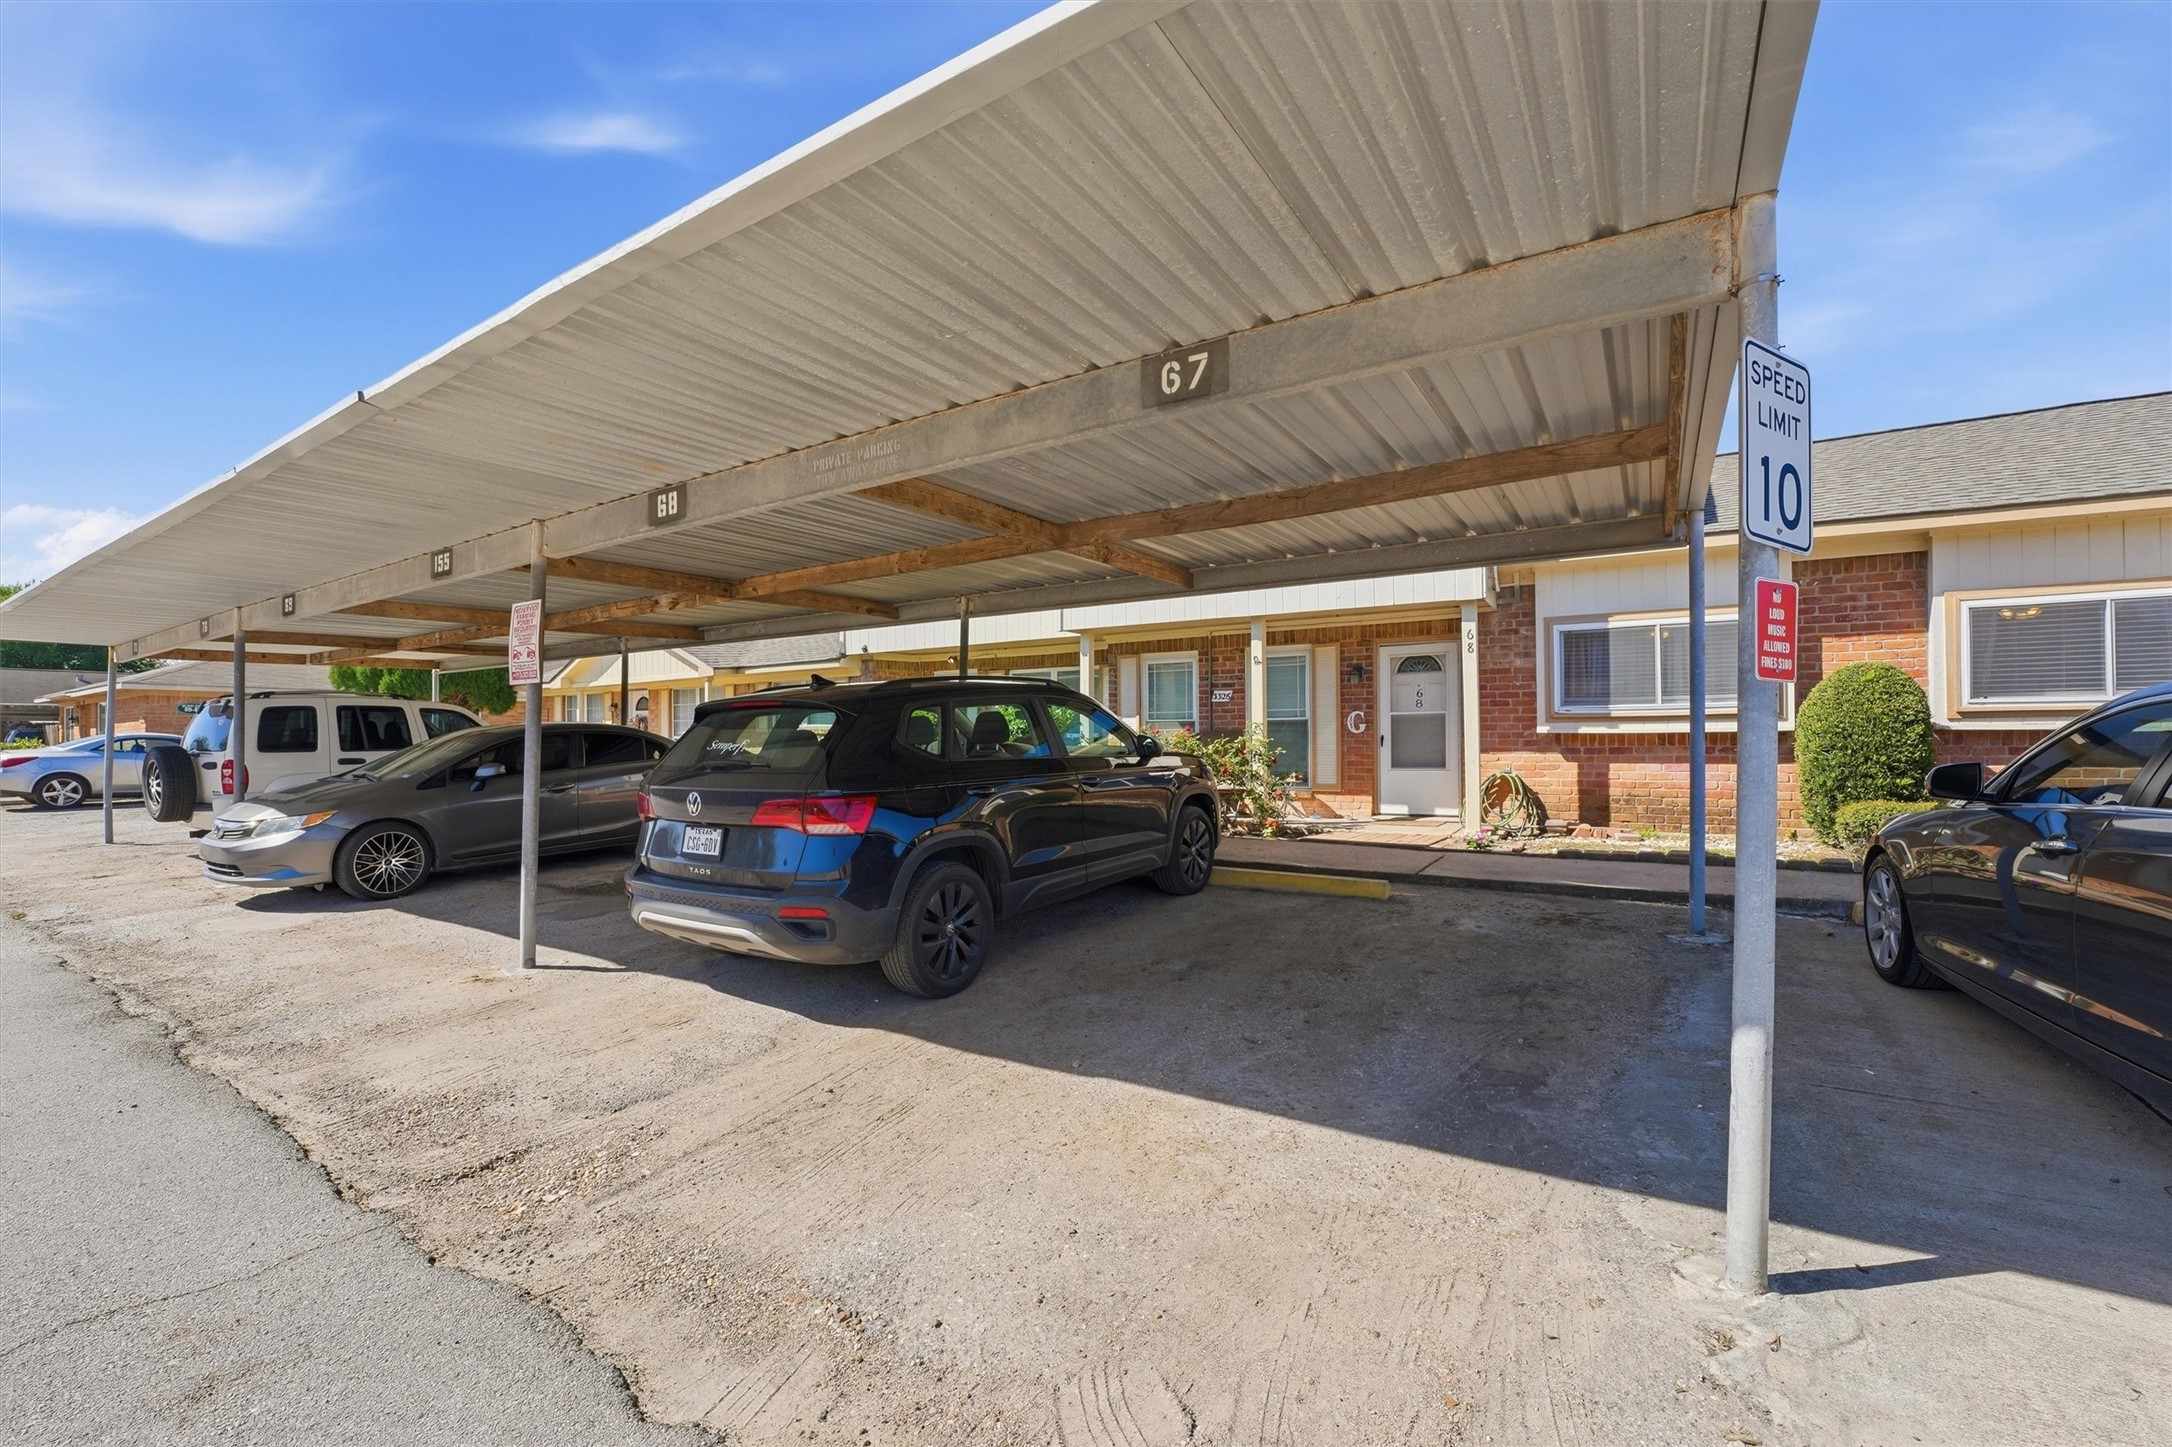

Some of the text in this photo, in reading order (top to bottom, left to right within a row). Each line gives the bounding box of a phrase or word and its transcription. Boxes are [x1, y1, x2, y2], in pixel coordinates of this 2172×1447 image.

[1161, 352, 1208, 395] 67
[1751, 360, 1805, 405] SPEED
[1758, 401, 1801, 440] LIMIT
[813, 438, 901, 473] PRIVATE PARKING
[657, 490, 678, 518] 68
[1761, 455, 1802, 531] 10
[434, 552, 450, 573] 155
[1772, 591, 1782, 604] NO
[1769, 607, 1785, 621] LOUD
[1767, 623, 1786, 637] MUSIC
[1763, 640, 1791, 654] ALLOWED
[1761, 656, 1792, 671] FINES $100
[1347, 710, 1367, 734] G
[689, 867, 711, 876] TAOS
